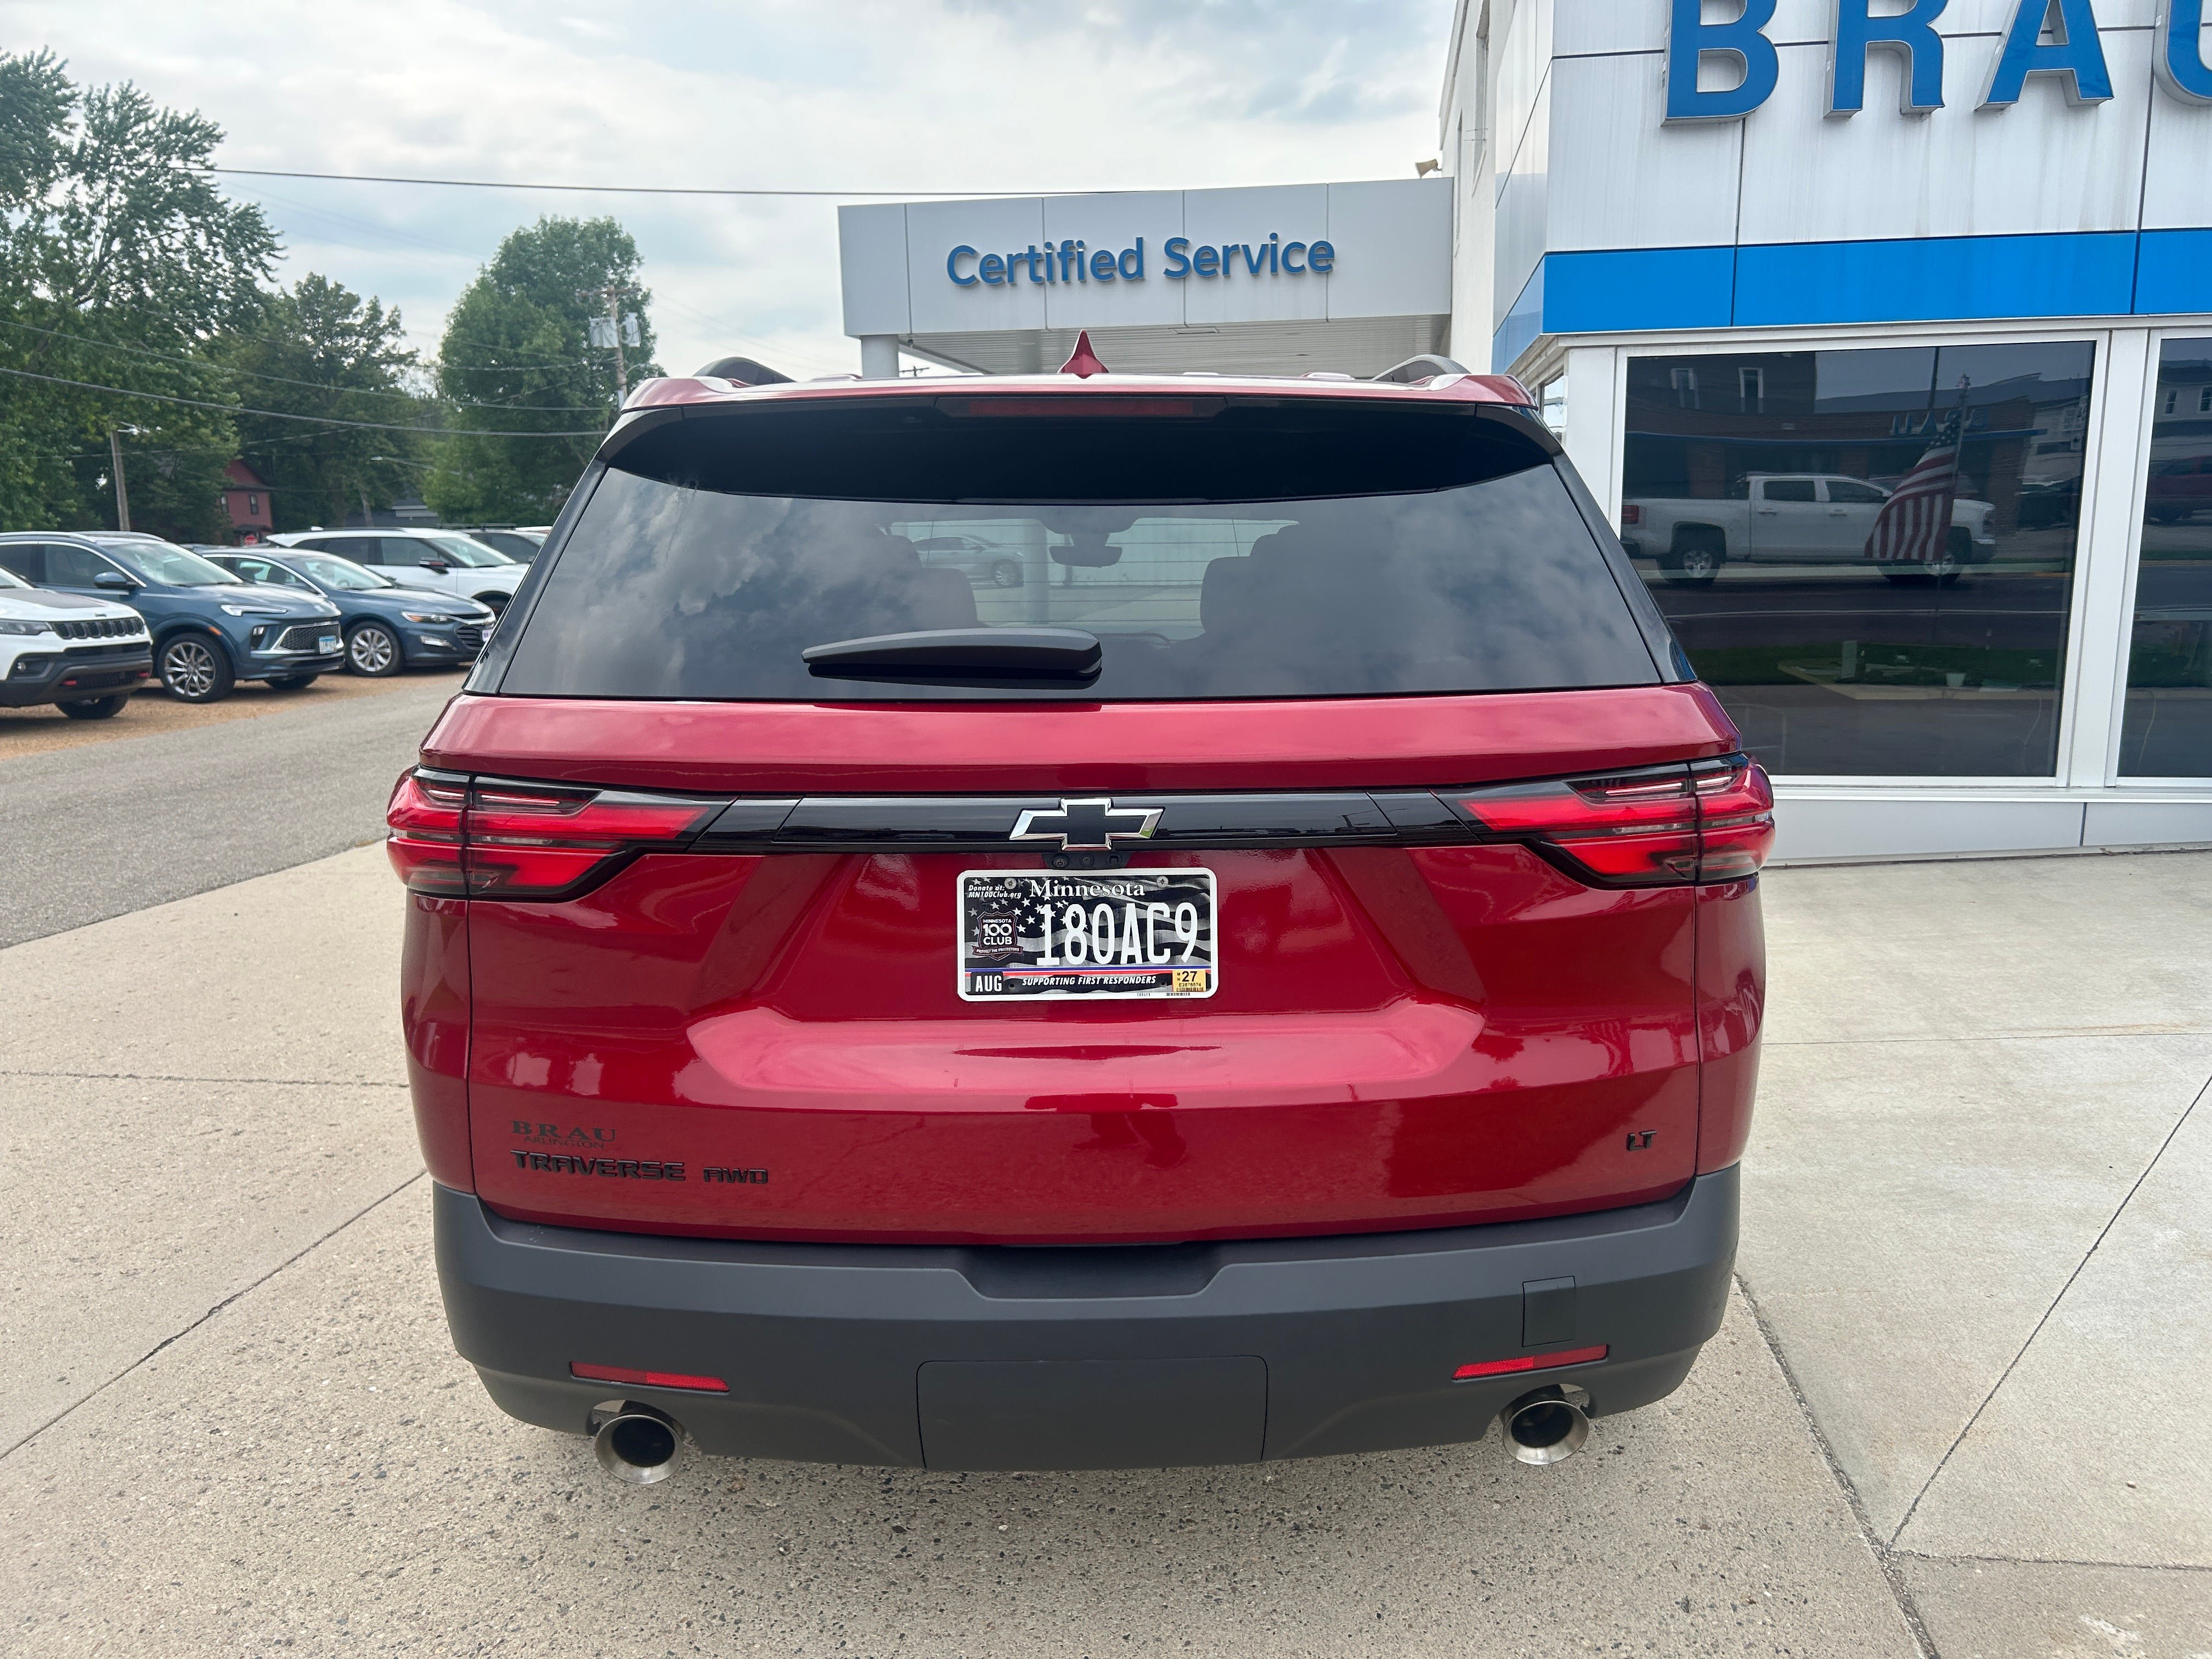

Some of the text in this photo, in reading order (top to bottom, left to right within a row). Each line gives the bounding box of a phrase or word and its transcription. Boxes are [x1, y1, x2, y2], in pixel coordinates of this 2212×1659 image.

[946, 232, 1336, 287] Certified Service
[968, 890, 1022, 899] MN100Club.org
[1029, 879, 1146, 898] Minnesota
[983, 923, 1012, 936] 100
[1036, 902, 1198, 966] 180AC9
[983, 936, 1012, 945] CLUB
[975, 975, 1003, 992] AUG
[1022, 975, 1156, 986] SUPPORTING FIRST RESPONDERS
[1182, 970, 1198, 982] 27
[510, 1120, 618, 1142] BRAU
[524, 1135, 605, 1149] ARLINGTON
[1626, 1130, 1658, 1152] LT
[510, 1150, 769, 1184] TRAVERSE AWD
